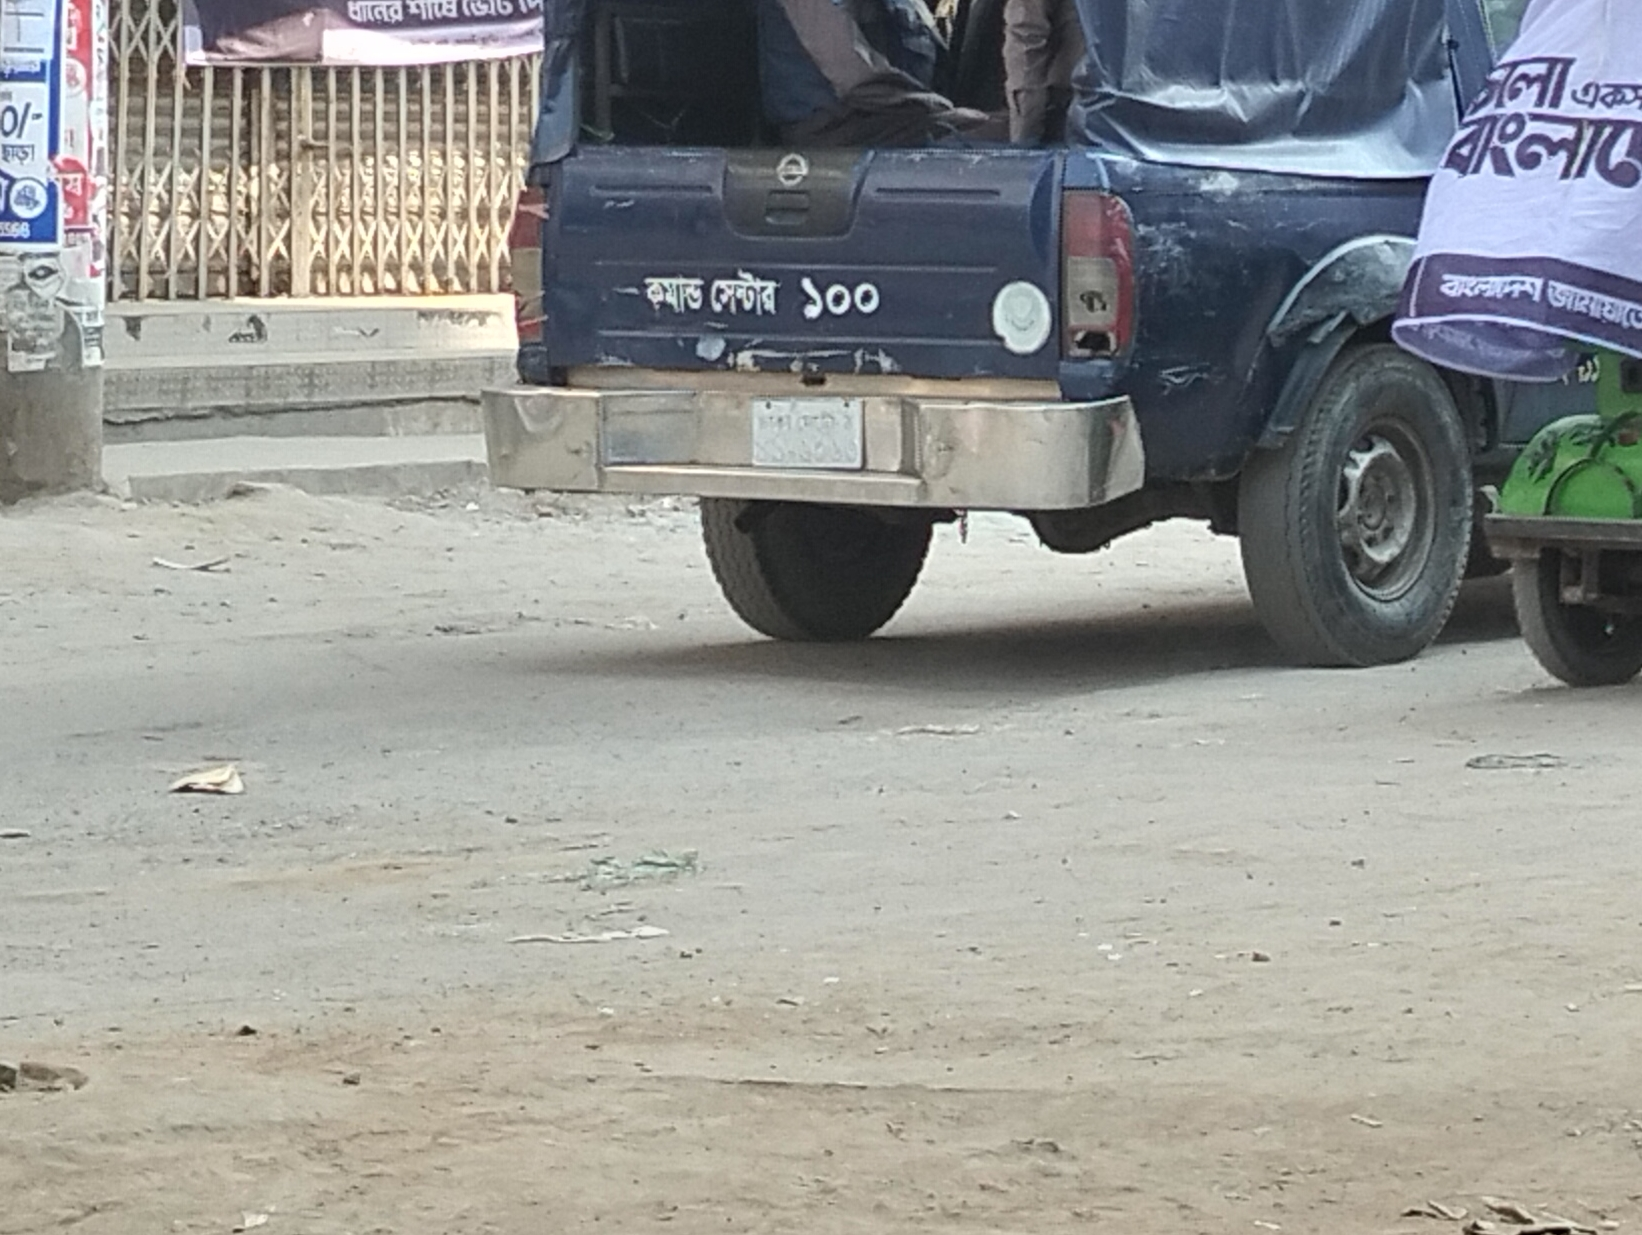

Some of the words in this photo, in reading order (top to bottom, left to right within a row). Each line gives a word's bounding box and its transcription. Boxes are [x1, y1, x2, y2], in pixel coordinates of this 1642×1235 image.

[711, 268, 780, 315] সেন্টার
[801, 277, 880, 319] ১০০
[1440, 274, 1545, 302] বাংলাদেশ
